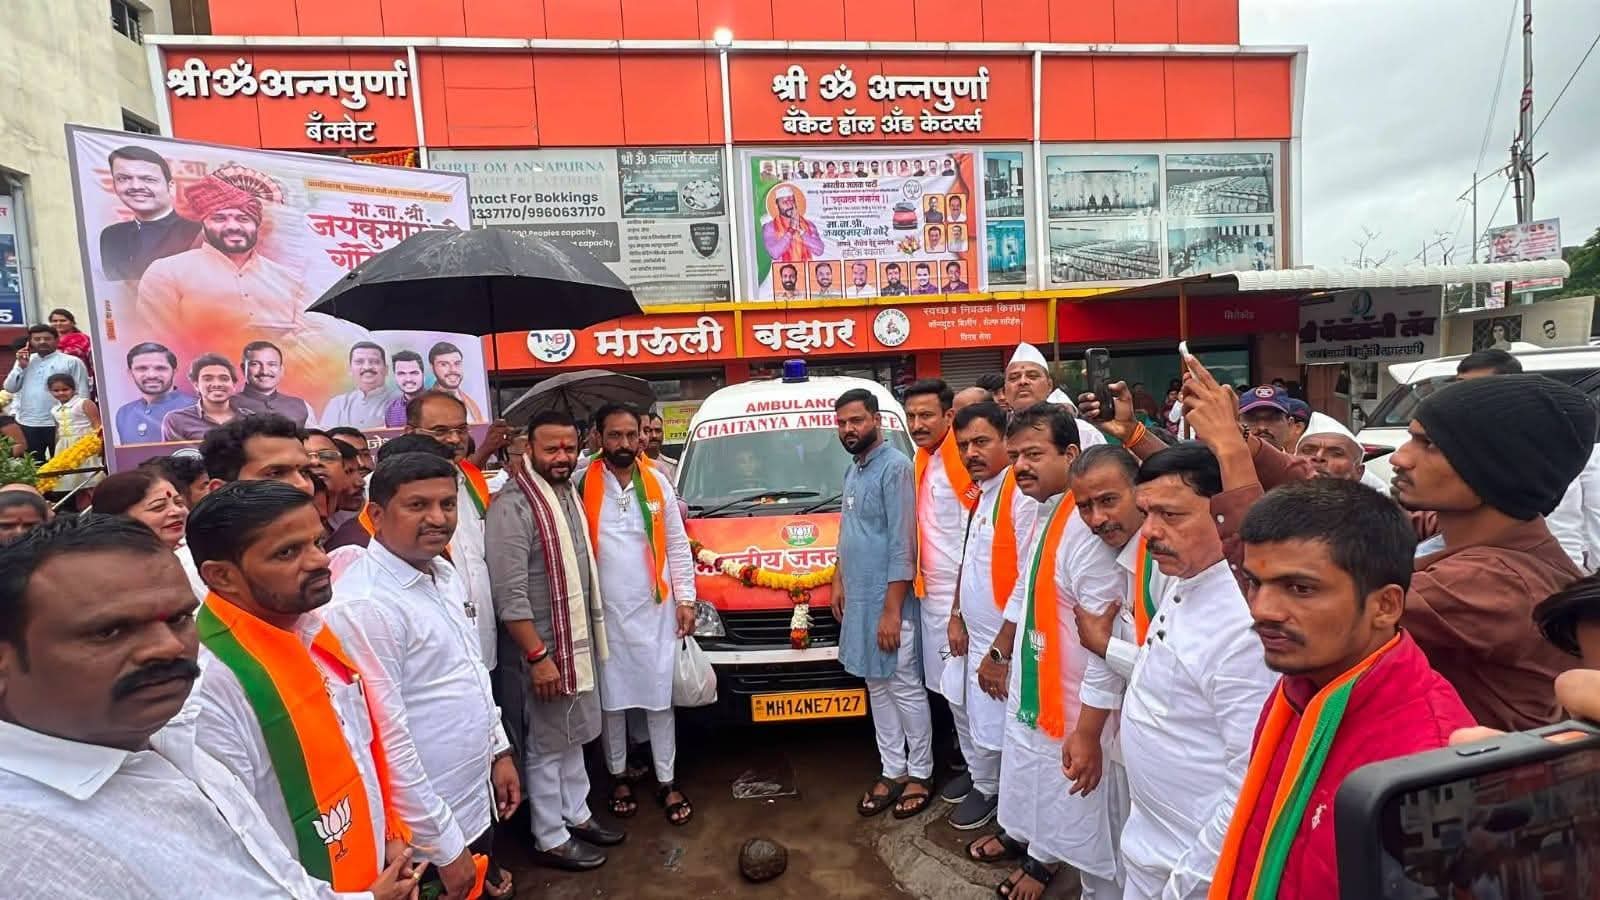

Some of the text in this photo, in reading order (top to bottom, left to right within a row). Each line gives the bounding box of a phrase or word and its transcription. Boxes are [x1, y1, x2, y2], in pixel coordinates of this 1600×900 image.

[167, 58, 211, 97] श्री
[772, 65, 808, 100] श्री
[838, 109, 875, 135] हॉल
[881, 106, 914, 133] अँड
[920, 109, 982, 132] केटरर्स
[514, 161, 606, 173] ANNAPURNA
[470, 192, 599, 205] ntact For Bokkings
[472, 206, 606, 221] 1337170/9960637170
[594, 316, 855, 356] माऊली बझार
[746, 398, 837, 413] AMBULANC
[697, 416, 789, 439] CHAITANYA
[766, 696, 861, 716] MH14NE7127
